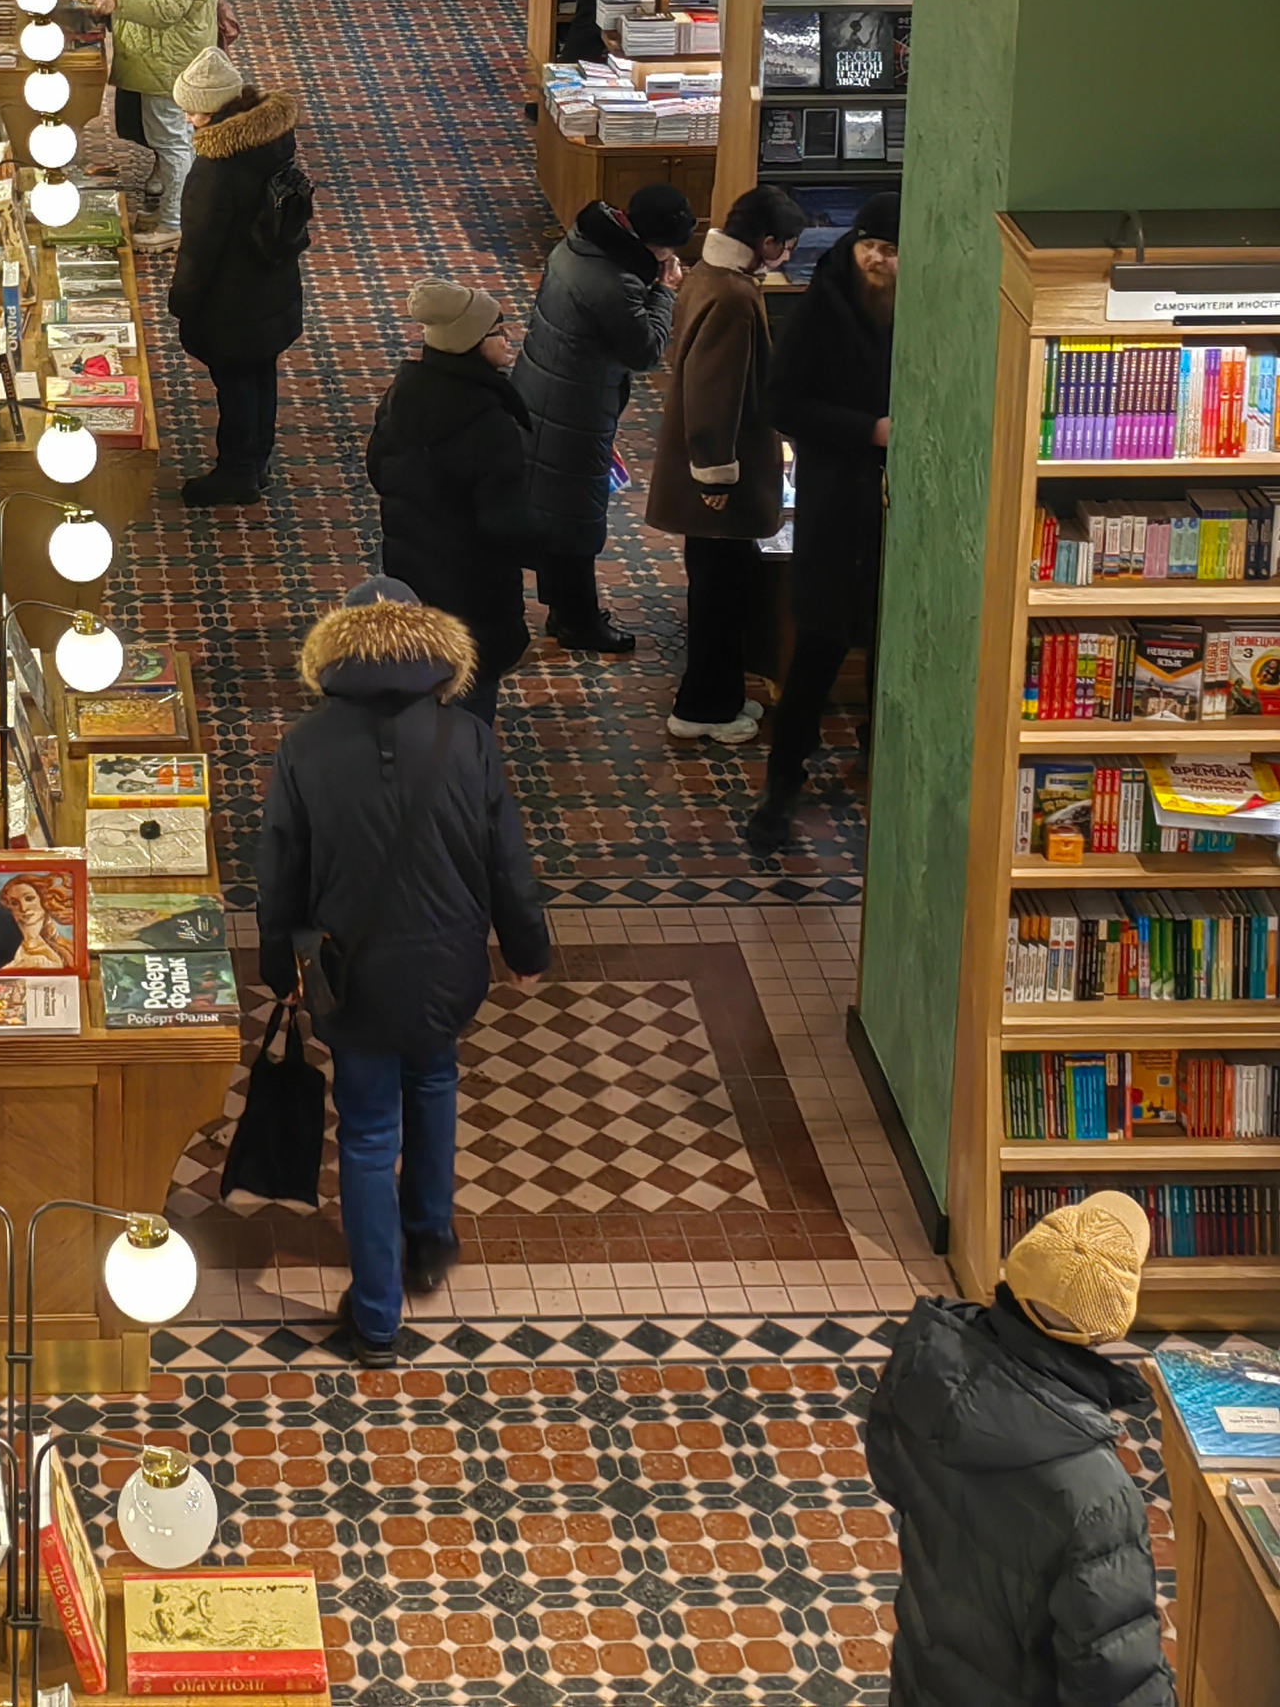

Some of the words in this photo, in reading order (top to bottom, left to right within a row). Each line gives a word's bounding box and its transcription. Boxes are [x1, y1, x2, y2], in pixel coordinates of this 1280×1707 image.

[836, 51, 882, 62] СЕСИЛ
[836, 61, 883, 73] БИТОН
[1154, 301, 1233, 312] САМОУЧИТЕЛИ
[5, 305, 19, 352] PIANO
[1243, 647, 1254, 659] 3
[1171, 765, 1253, 780] ВРЕМЕНА
[141, 954, 169, 1009] Роберт
[166, 957, 192, 1009] Фальк
[127, 1012, 173, 1026] Роберт
[175, 1012, 220, 1024] Фальк
[49, 1562, 83, 1637] РАФАЭЛЬ
[173, 1679, 265, 1693] ЛЕОНАРДО
